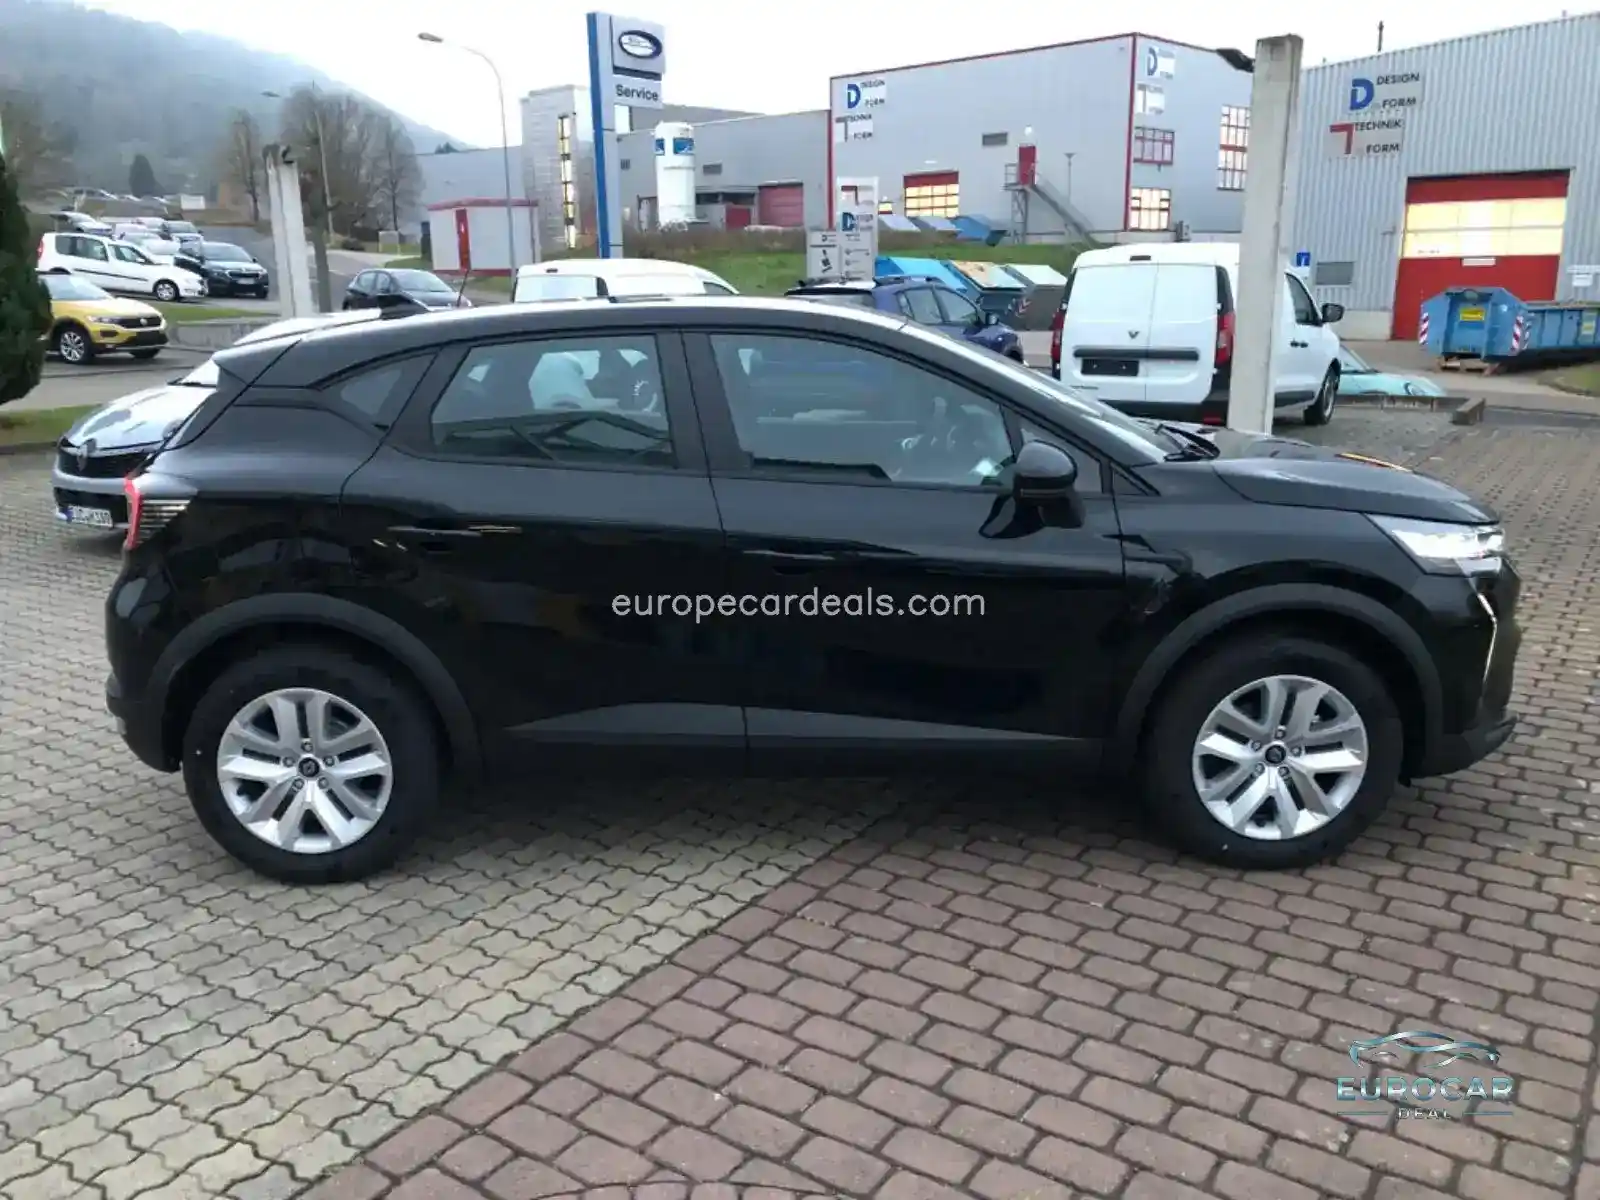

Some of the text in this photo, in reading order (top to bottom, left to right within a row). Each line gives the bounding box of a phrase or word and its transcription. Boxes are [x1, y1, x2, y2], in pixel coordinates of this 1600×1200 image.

[1376, 73, 1420, 85] DESIGN
[615, 84, 659, 102] Service
[847, 84, 861, 109] D
[1350, 78, 1374, 111] D
[1382, 97, 1417, 109] FORM
[1355, 120, 1402, 131] TECHNIK
[1366, 143, 1399, 154] FORM
